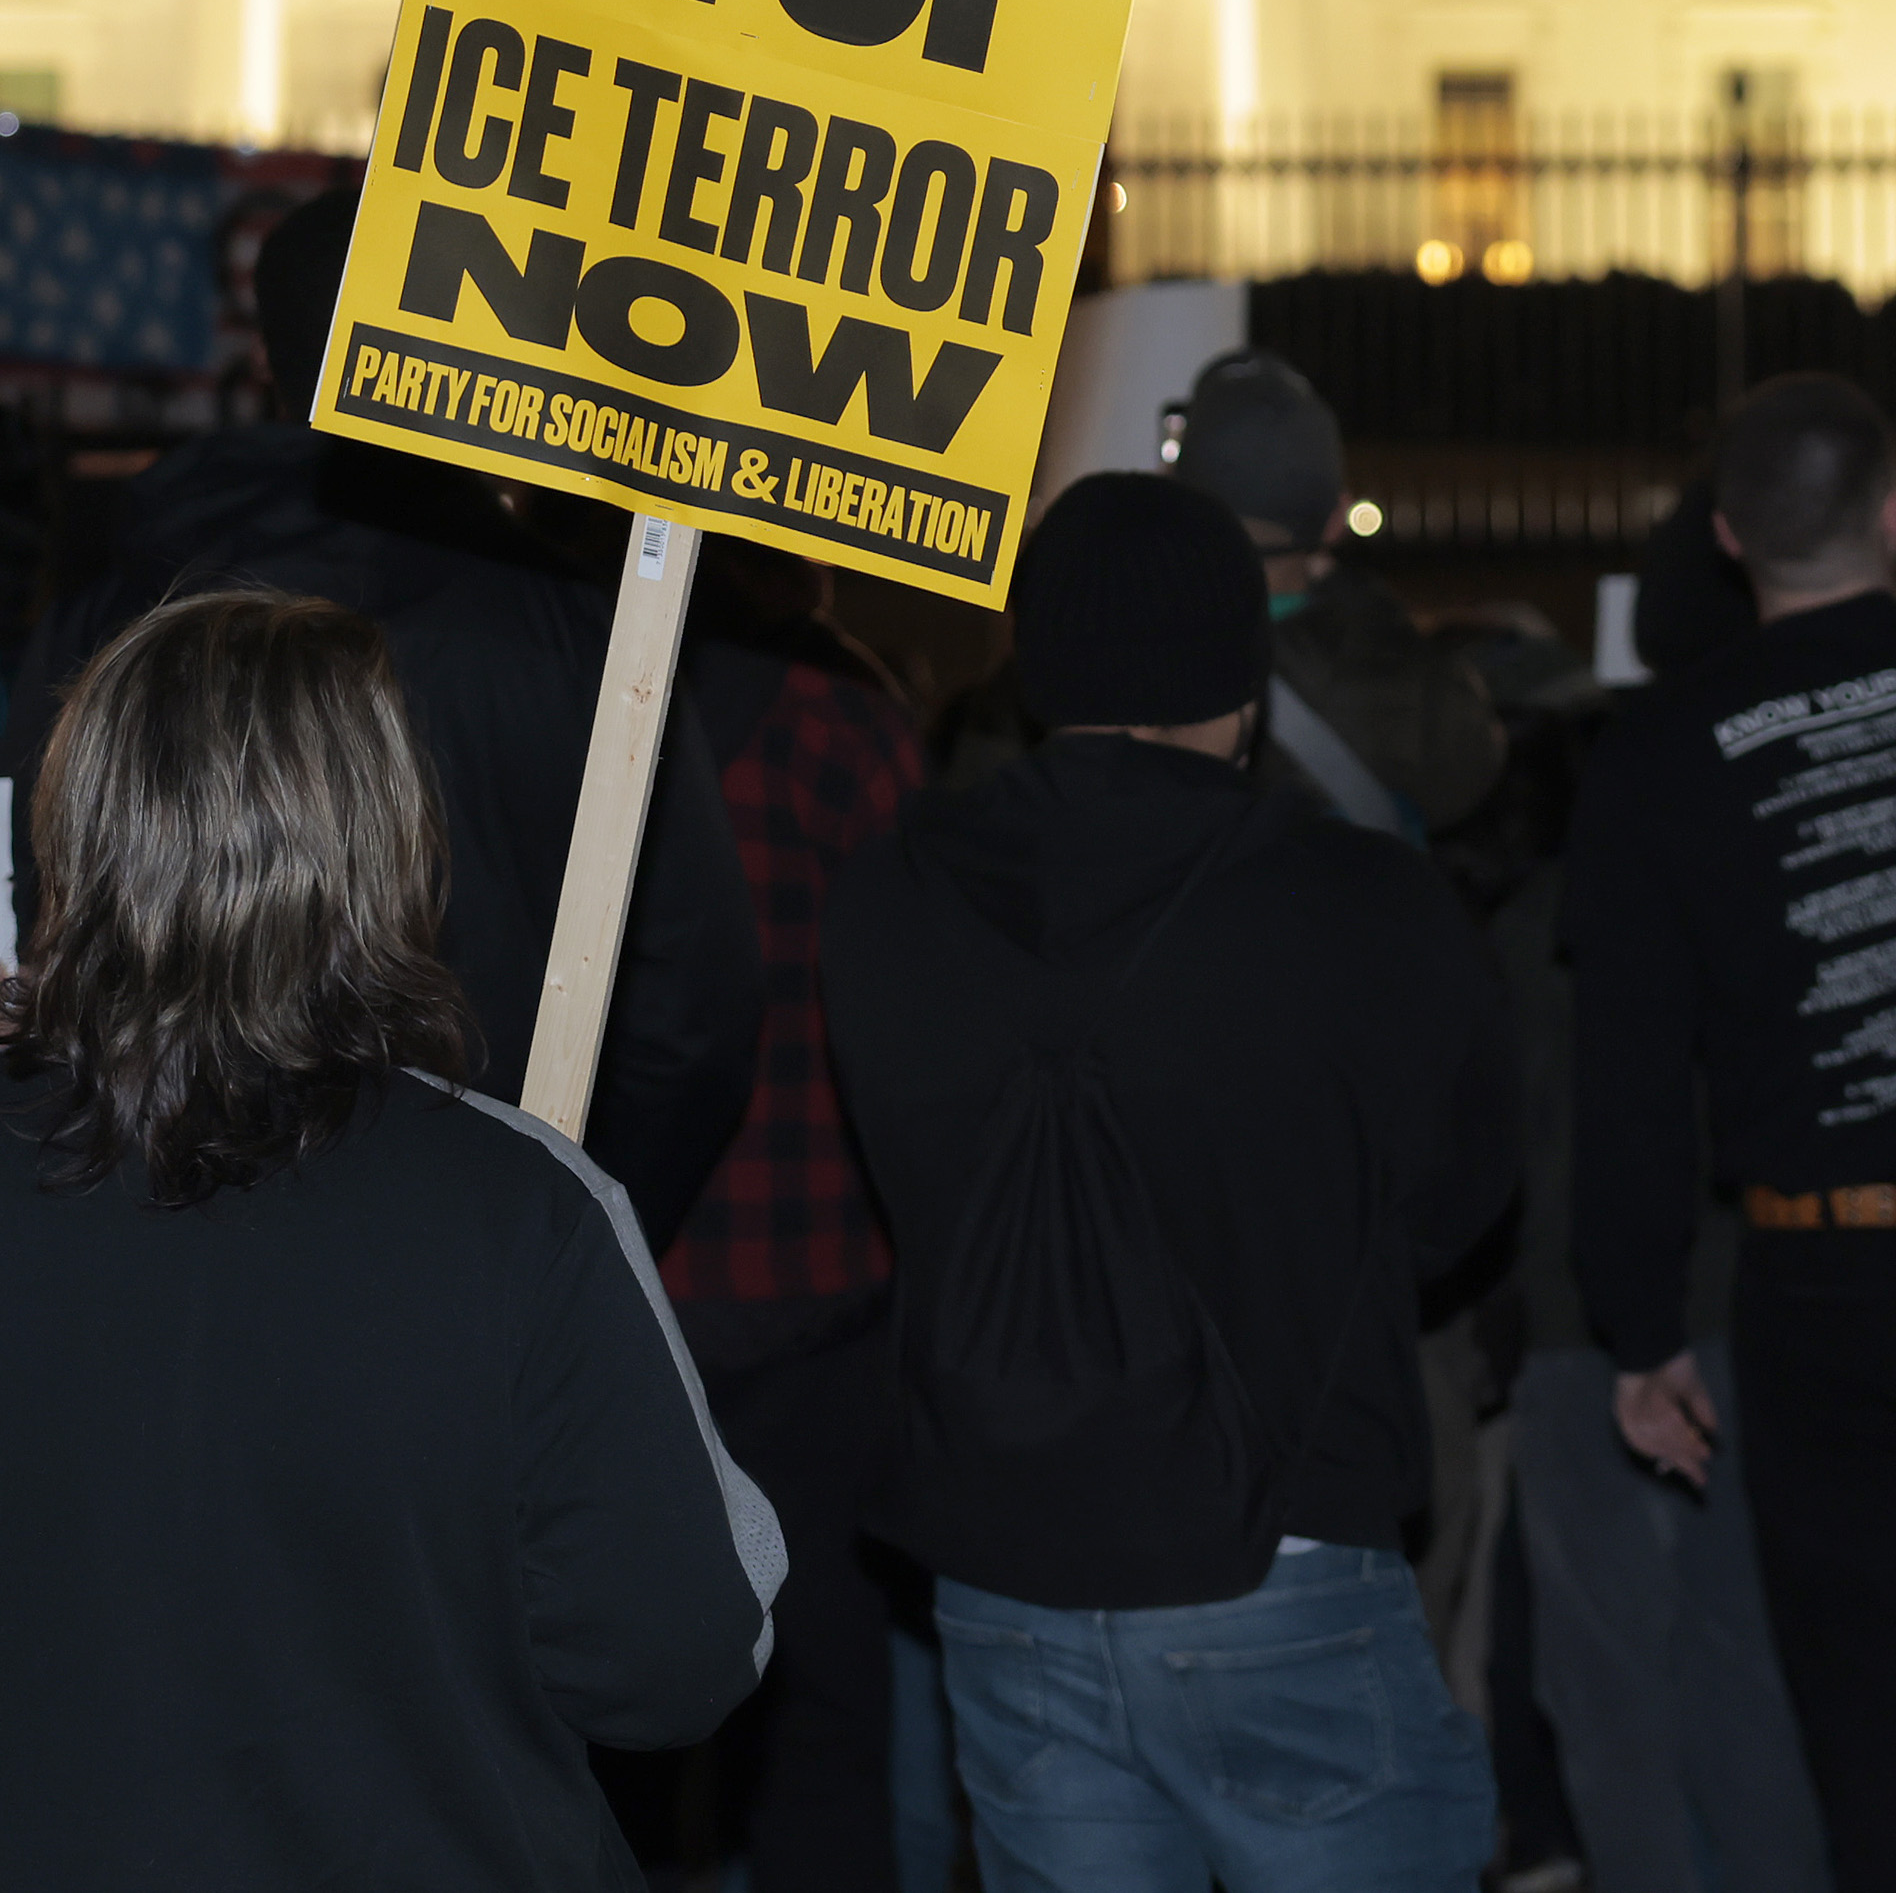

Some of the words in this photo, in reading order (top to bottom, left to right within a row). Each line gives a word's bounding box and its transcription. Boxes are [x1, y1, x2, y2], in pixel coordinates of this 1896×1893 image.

[392, 4, 592, 211] ICE
[608, 55, 1060, 337] TERROR
[350, 344, 473, 423] PARTY
[467, 377, 542, 441] FOR
[544, 393, 730, 492] SOCIALISM
[731, 447, 777, 504] &
[784, 457, 992, 563] LIBERATION
[398, 199, 1004, 454] NOW
